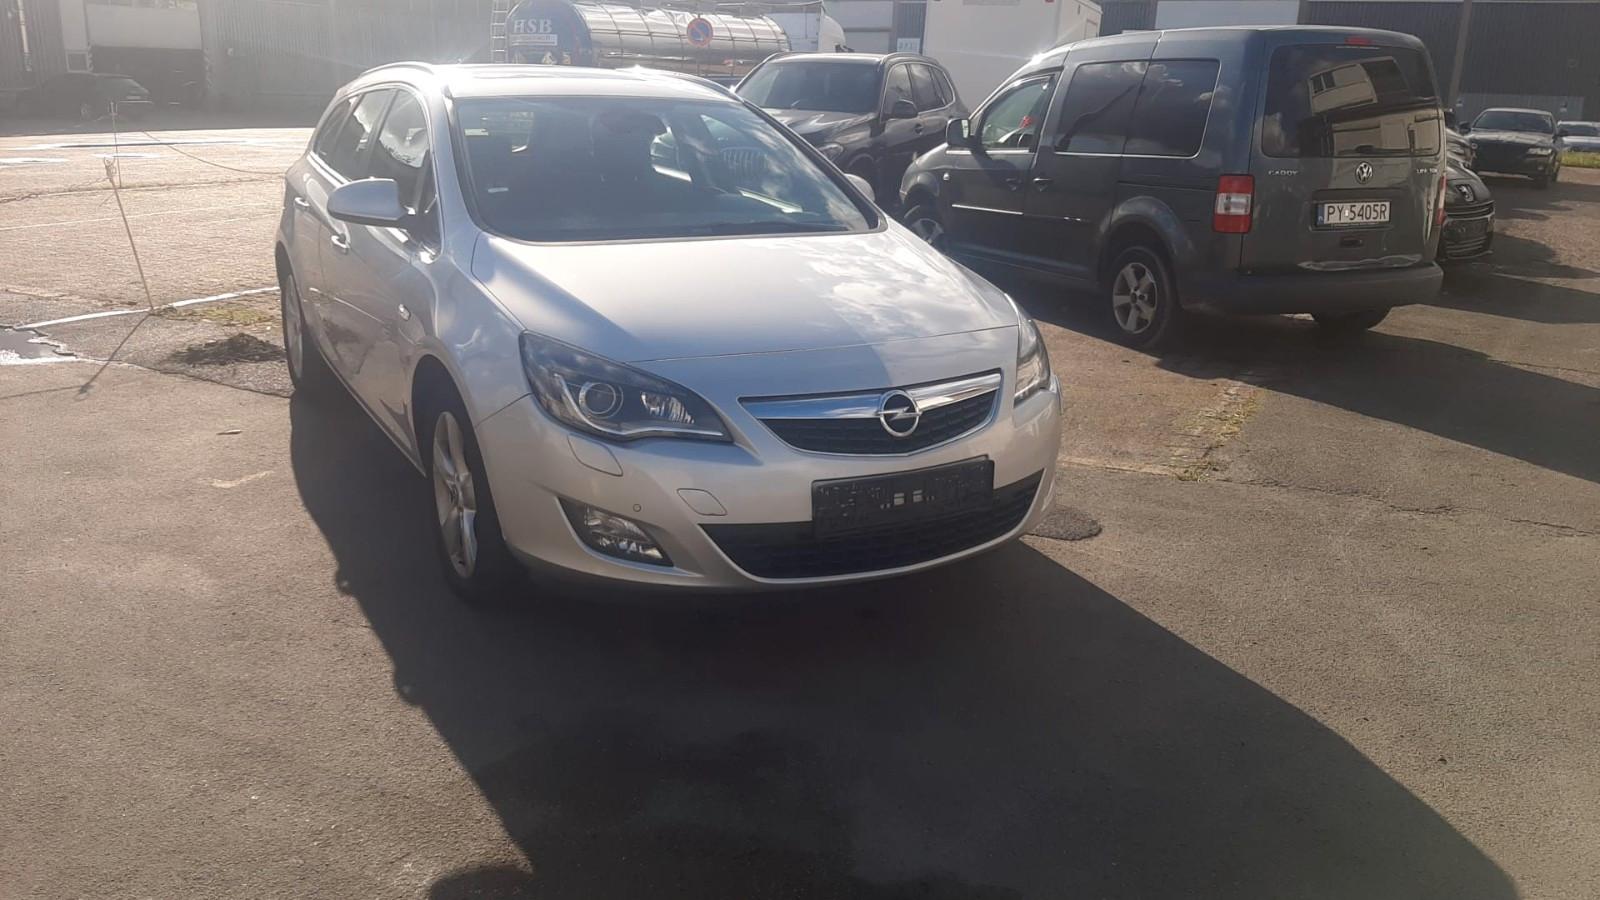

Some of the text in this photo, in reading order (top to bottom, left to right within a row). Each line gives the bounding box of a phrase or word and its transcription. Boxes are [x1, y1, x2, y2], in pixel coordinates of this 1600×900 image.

[513, 18, 553, 33] HSB
[1327, 205, 1344, 222] PY
[1349, 203, 1387, 221] 5405R
